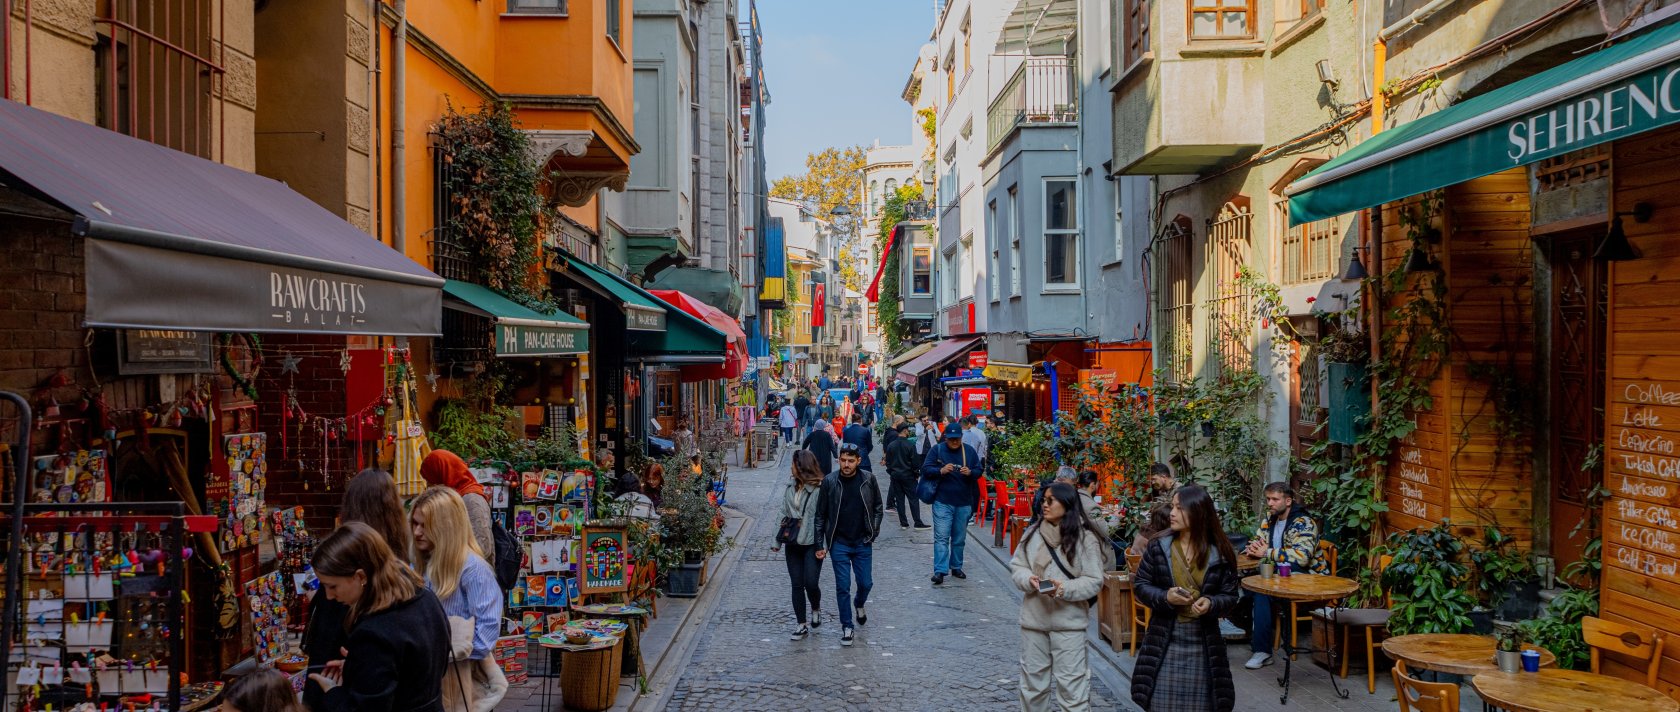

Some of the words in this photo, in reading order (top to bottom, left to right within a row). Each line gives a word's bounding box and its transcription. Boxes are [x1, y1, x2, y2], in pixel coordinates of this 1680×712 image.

[270, 272, 366, 314] RAWCRAFTS
[285, 310, 355, 326] BALAT
[503, 326, 518, 353] PH
[524, 331, 555, 349] PAN-CAKE
[556, 332, 574, 349] HOUSE
[1624, 383, 1680, 405] Coffee
[1622, 406, 1663, 427] Latte
[1400, 446, 1422, 465] Sweet
[1619, 454, 1658, 475] Turkish
[1401, 463, 1429, 484] Sandwich
[1400, 481, 1423, 499] Pasta
[1402, 498, 1426, 519] Salad
[1645, 506, 1678, 530] Coffee
[1621, 524, 1639, 541] Ice
[1639, 528, 1677, 553] Coffee
[1617, 547, 1639, 570] Cold
[1642, 554, 1677, 577] Brew
[586, 579, 623, 589] HANDMADE
